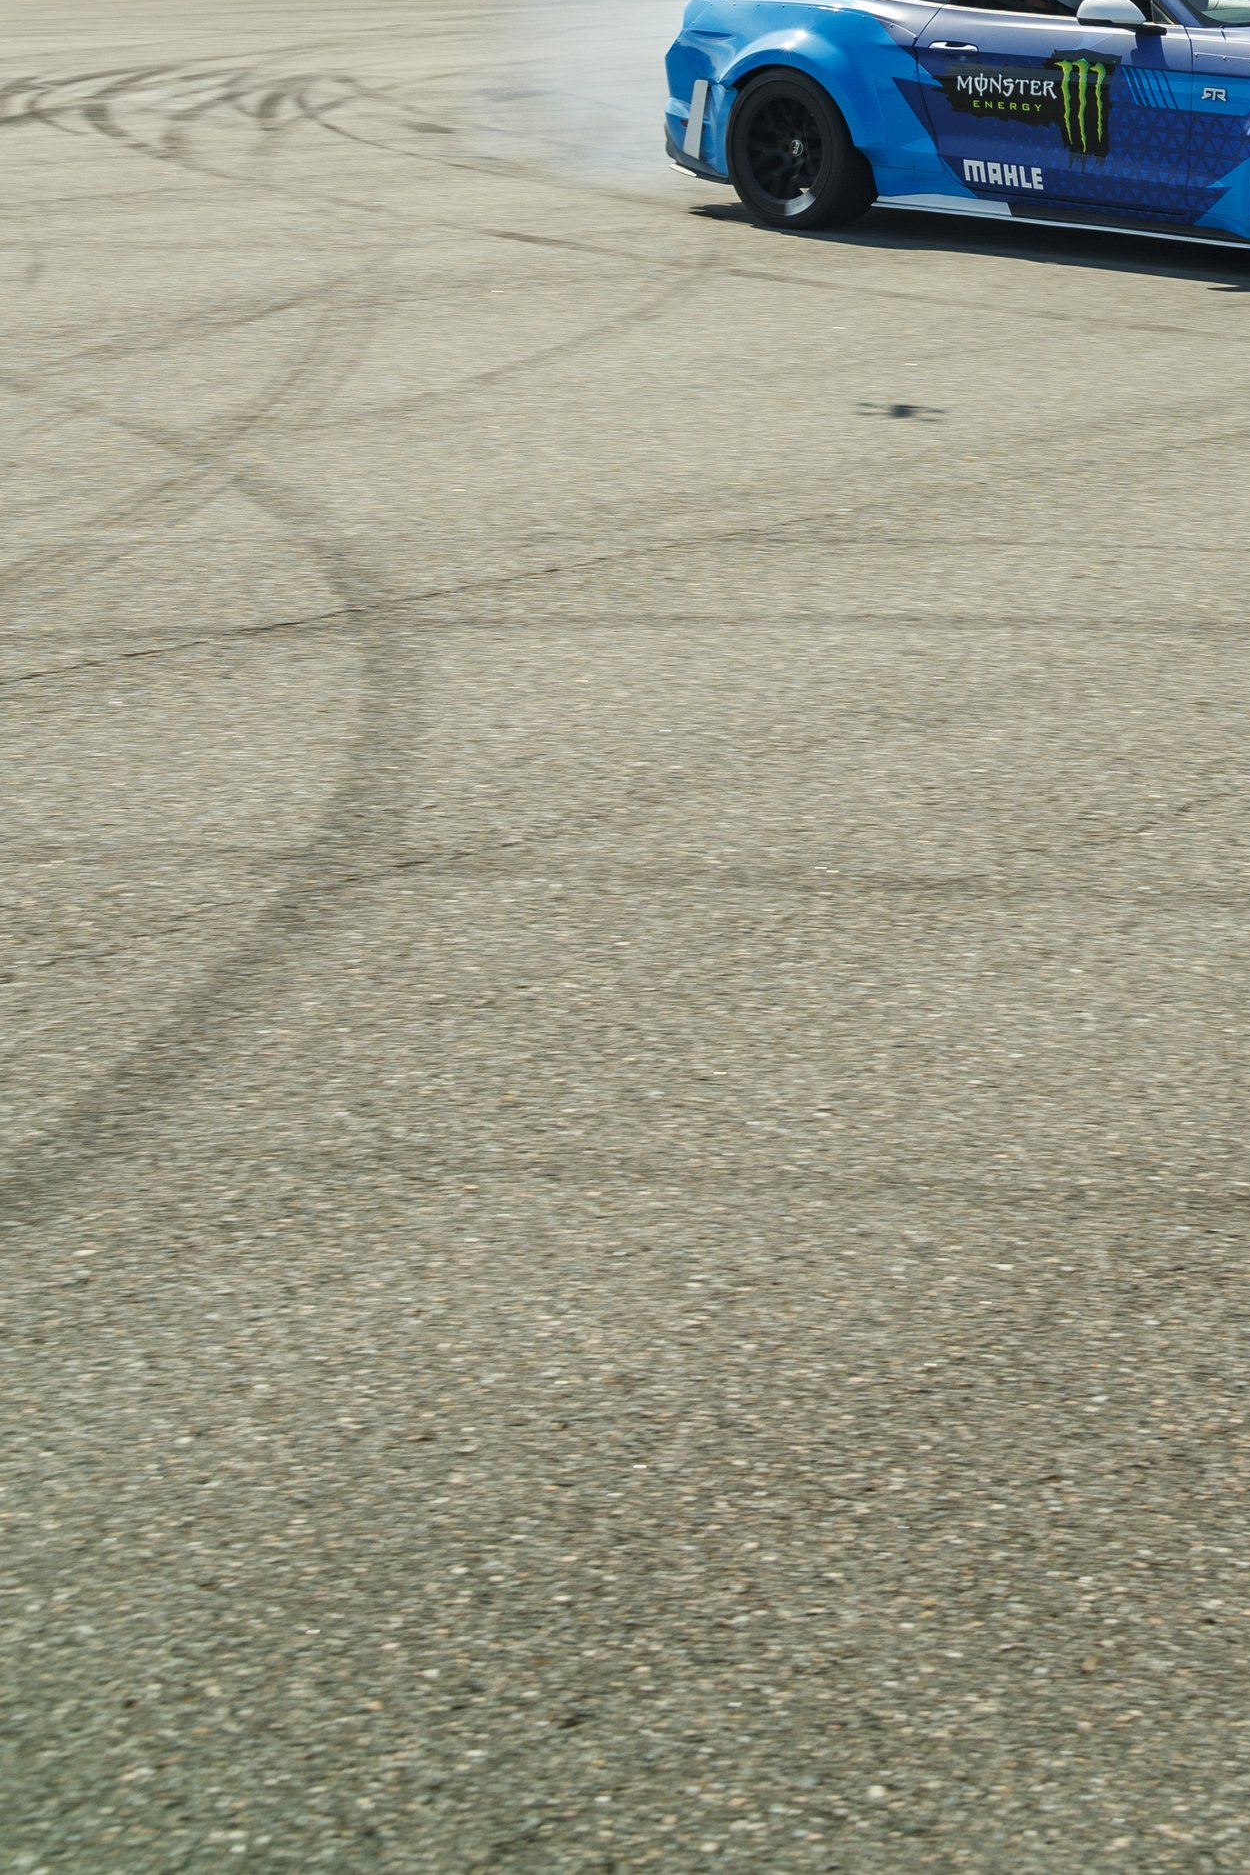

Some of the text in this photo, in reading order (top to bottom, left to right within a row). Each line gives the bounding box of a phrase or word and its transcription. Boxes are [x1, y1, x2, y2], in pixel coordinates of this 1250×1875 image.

[956, 72, 1057, 100] MONSTER
[1201, 87, 1227, 102] RTR
[972, 100, 1042, 112] ENERGY
[963, 159, 1044, 191] MAHLE
